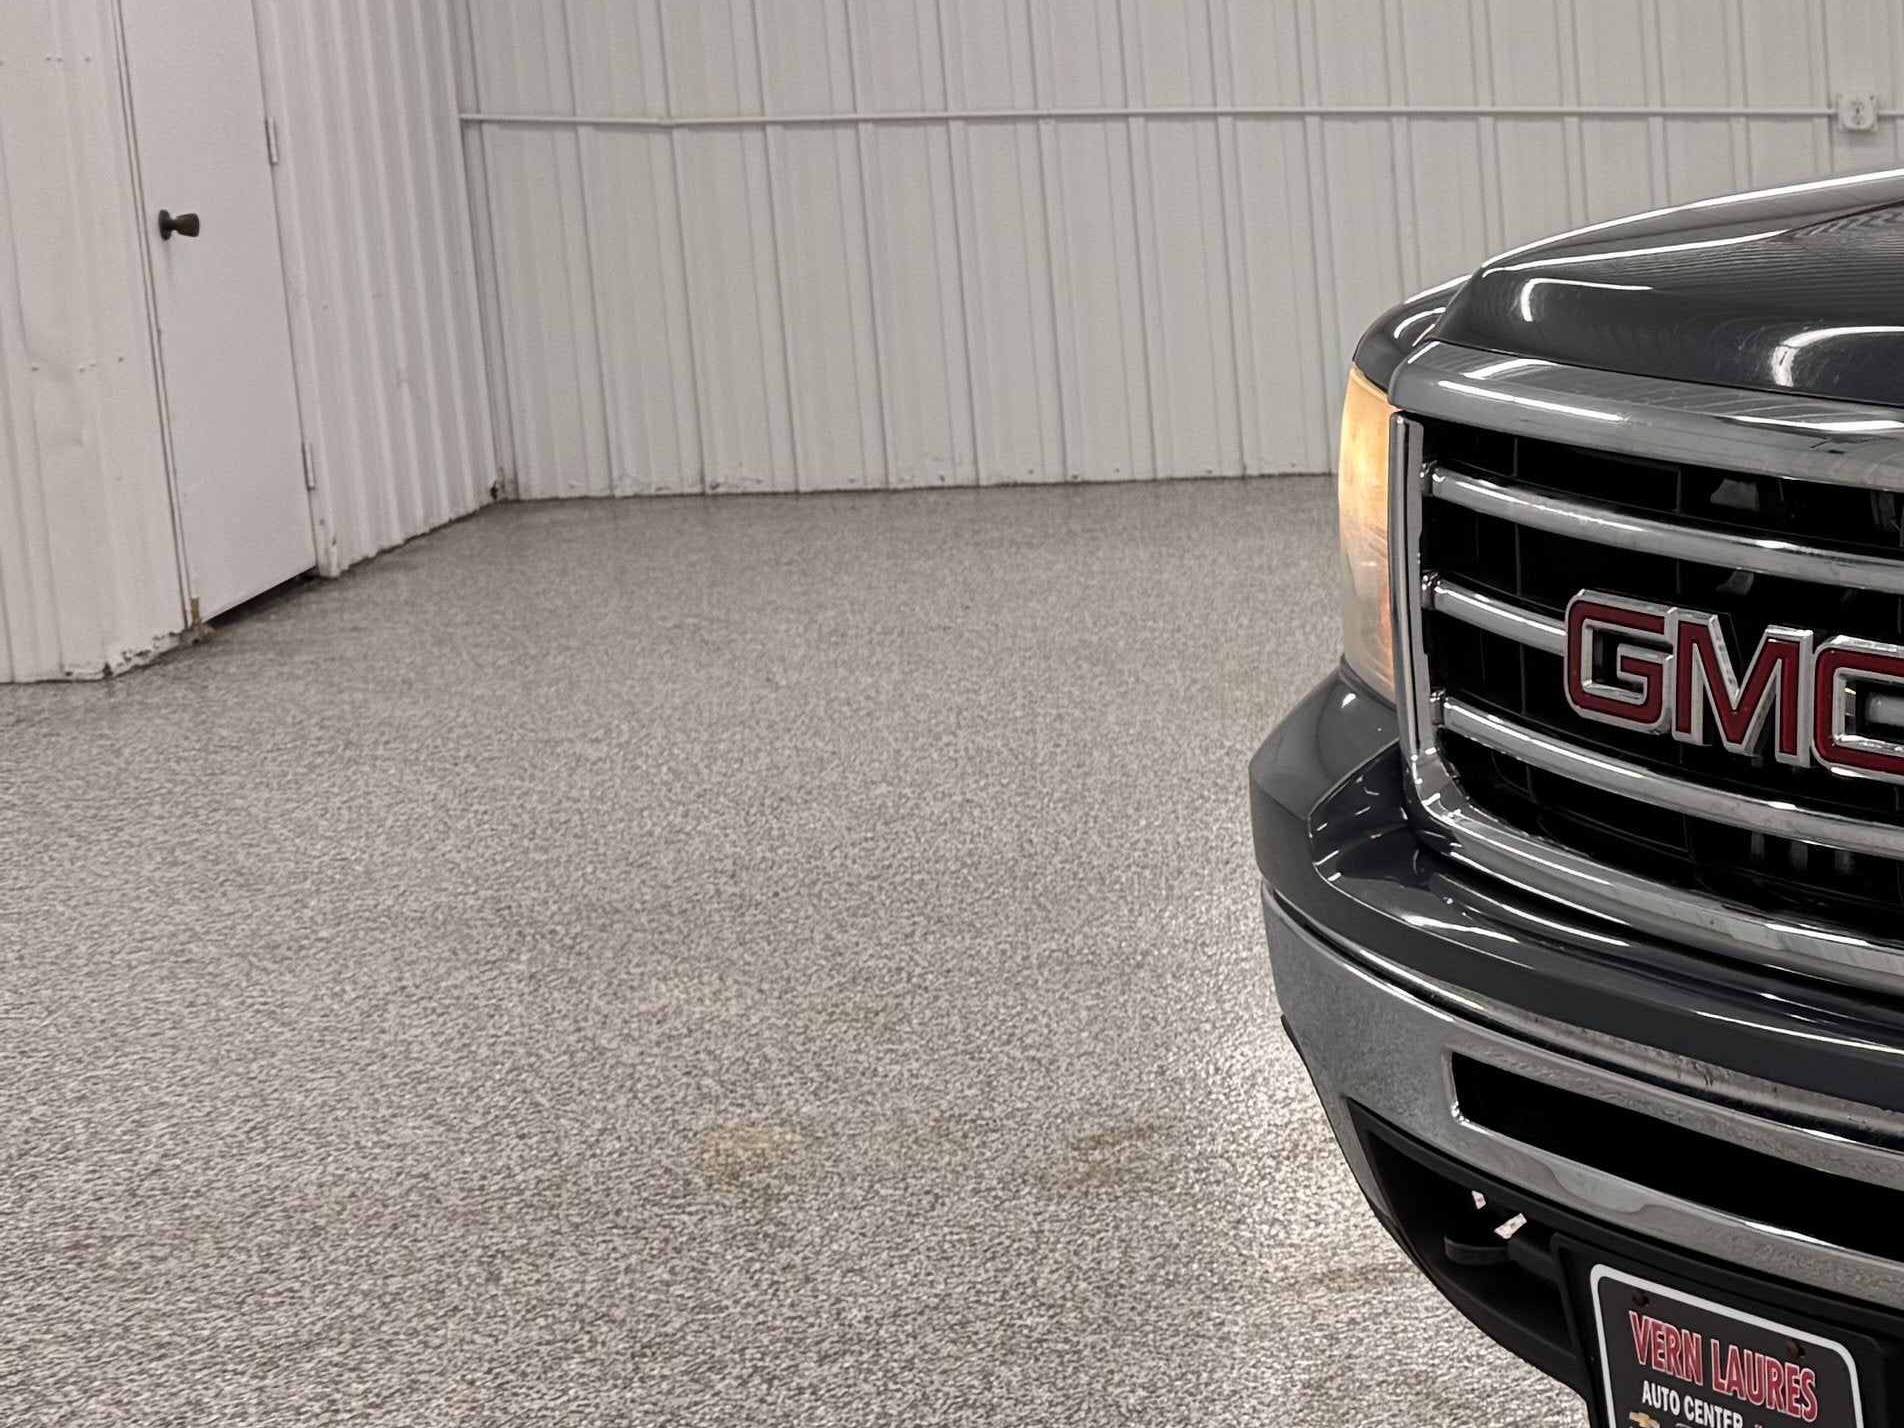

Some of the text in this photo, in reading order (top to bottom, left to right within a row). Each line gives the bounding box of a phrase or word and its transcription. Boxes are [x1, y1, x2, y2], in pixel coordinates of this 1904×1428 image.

[1629, 1310, 1819, 1423] VERN LAURES
[1641, 1380, 1681, 1416] AUTO
